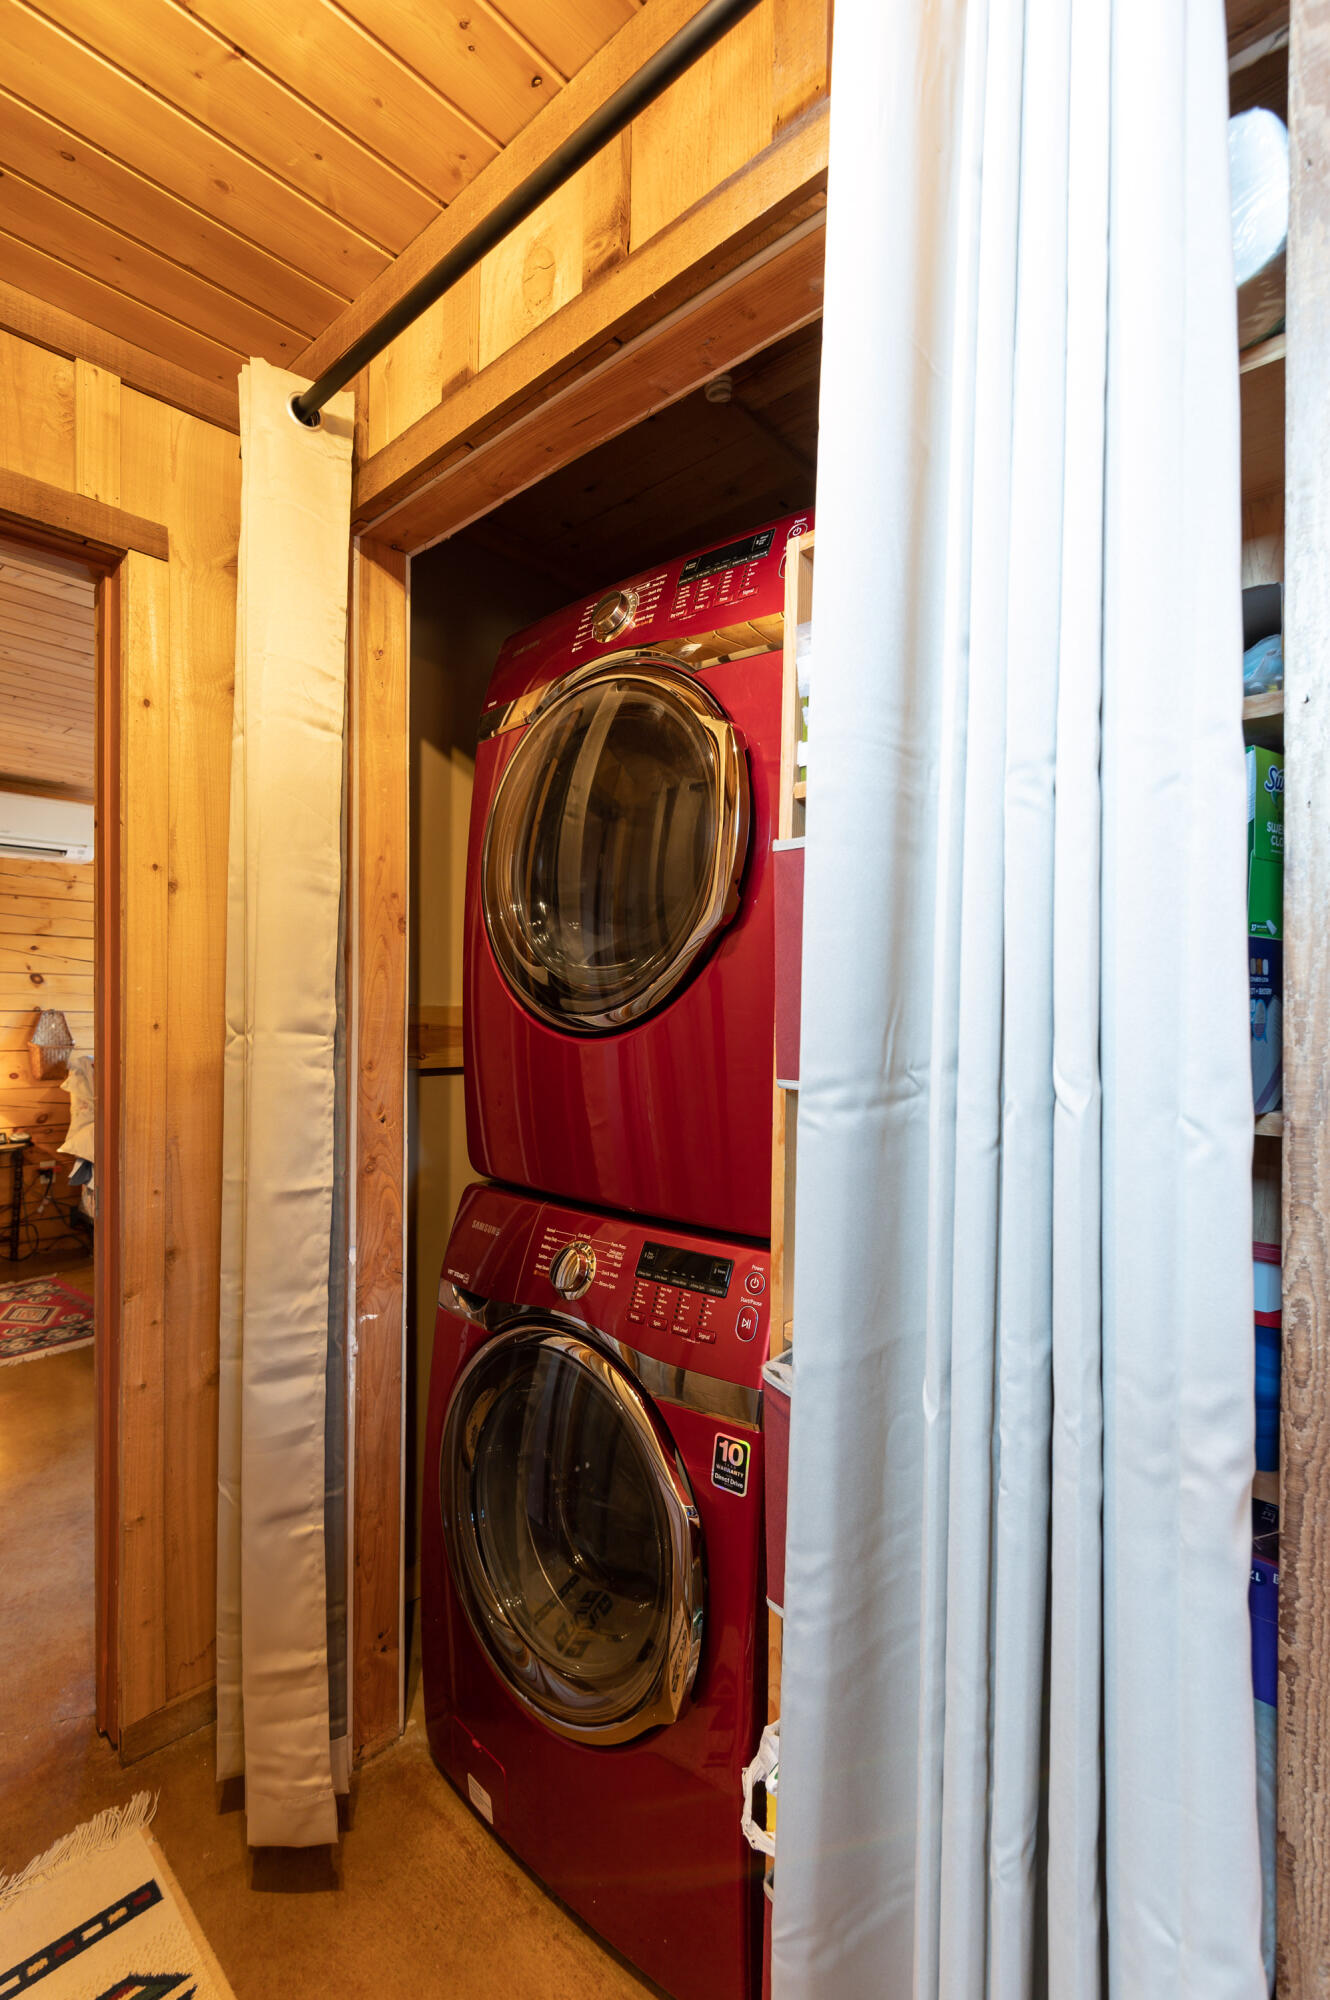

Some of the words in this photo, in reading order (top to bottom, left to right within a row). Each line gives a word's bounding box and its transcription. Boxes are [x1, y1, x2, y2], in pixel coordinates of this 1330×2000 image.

[472, 1219, 501, 1237] SAMSUNG
[751, 1264, 765, 1272] Power
[740, 1296, 763, 1307] Start/Pause
[719, 1440, 744, 1466] 10
[716, 1464, 744, 1478] WARRANTY
[714, 1472, 730, 1484] Direct
[730, 1478, 744, 1489] Drive
